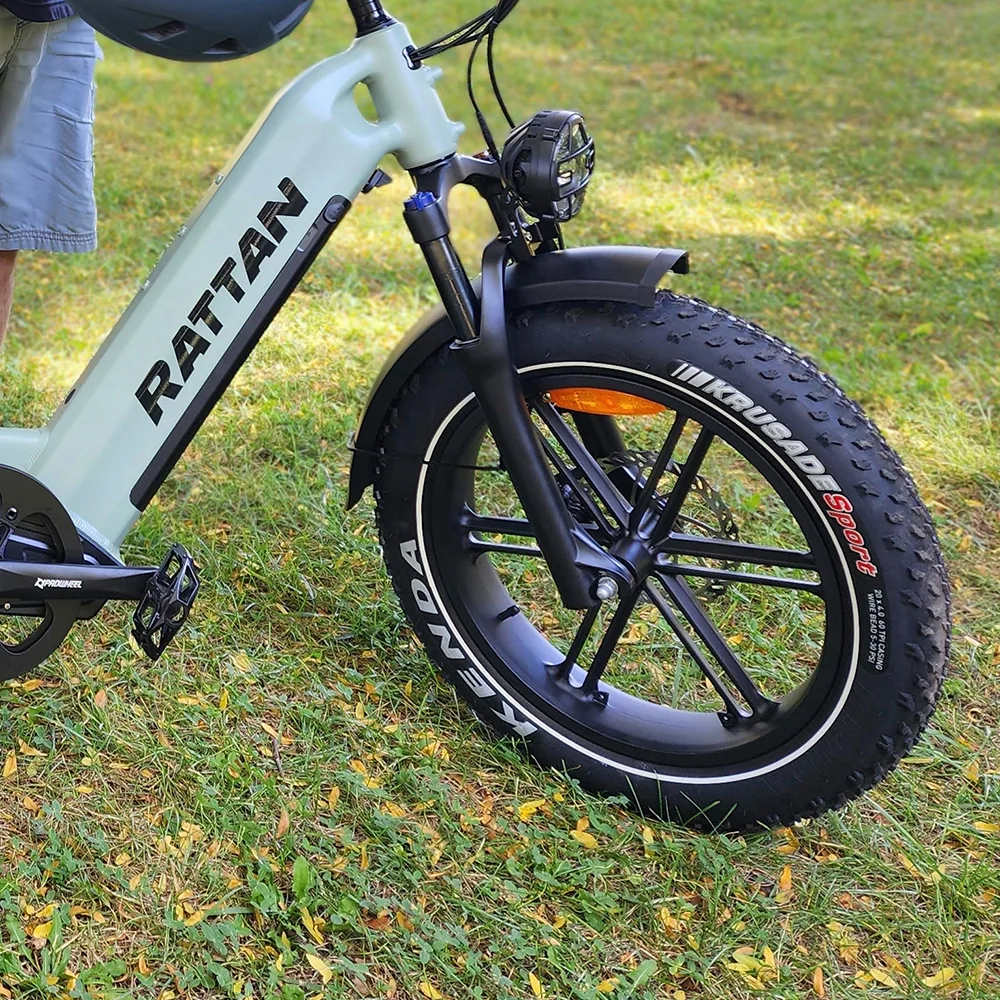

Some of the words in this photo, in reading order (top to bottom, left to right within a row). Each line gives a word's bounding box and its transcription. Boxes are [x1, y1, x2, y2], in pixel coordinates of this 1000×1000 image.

[134, 176, 309, 427] RATTAN
[701, 379, 842, 492] KRUSADE
[822, 492, 879, 578] Sport
[42, 578, 83, 589] PROWHEEL
[867, 593, 877, 613] WIRE
[874, 589, 883, 599] 20
[869, 614, 878, 634] BEAD
[878, 620, 886, 629] 60
[399, 539, 538, 737] KENDA
[869, 634, 878, 651] 5-30
[878, 630, 886, 642] TPI
[867, 651, 876, 664] PSI
[875, 643, 886, 671] CASING
